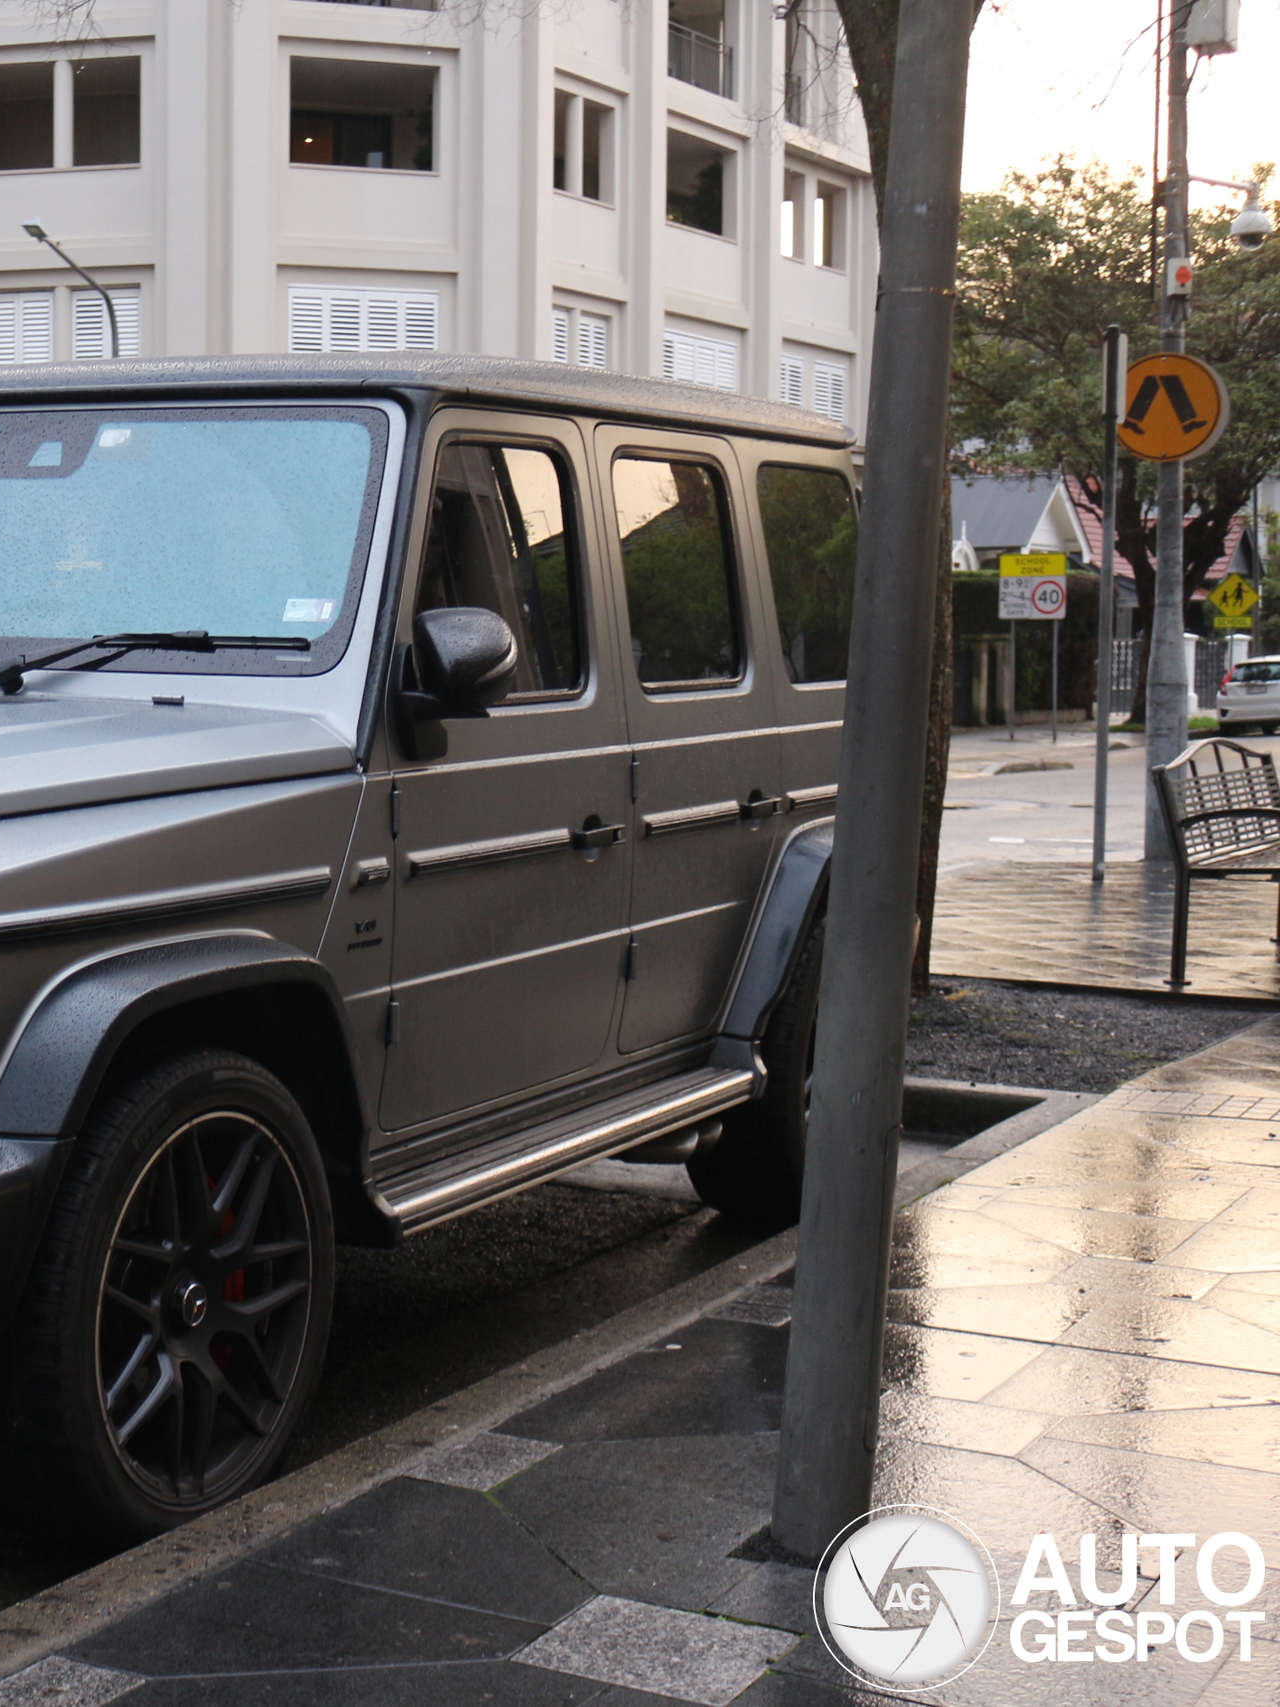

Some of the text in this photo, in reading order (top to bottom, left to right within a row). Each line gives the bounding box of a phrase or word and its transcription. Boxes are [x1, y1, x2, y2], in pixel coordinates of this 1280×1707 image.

[1020, 566, 1045, 574] ZONE
[1038, 589, 1060, 605] 40
[1217, 618, 1247, 626] SCHOOL
